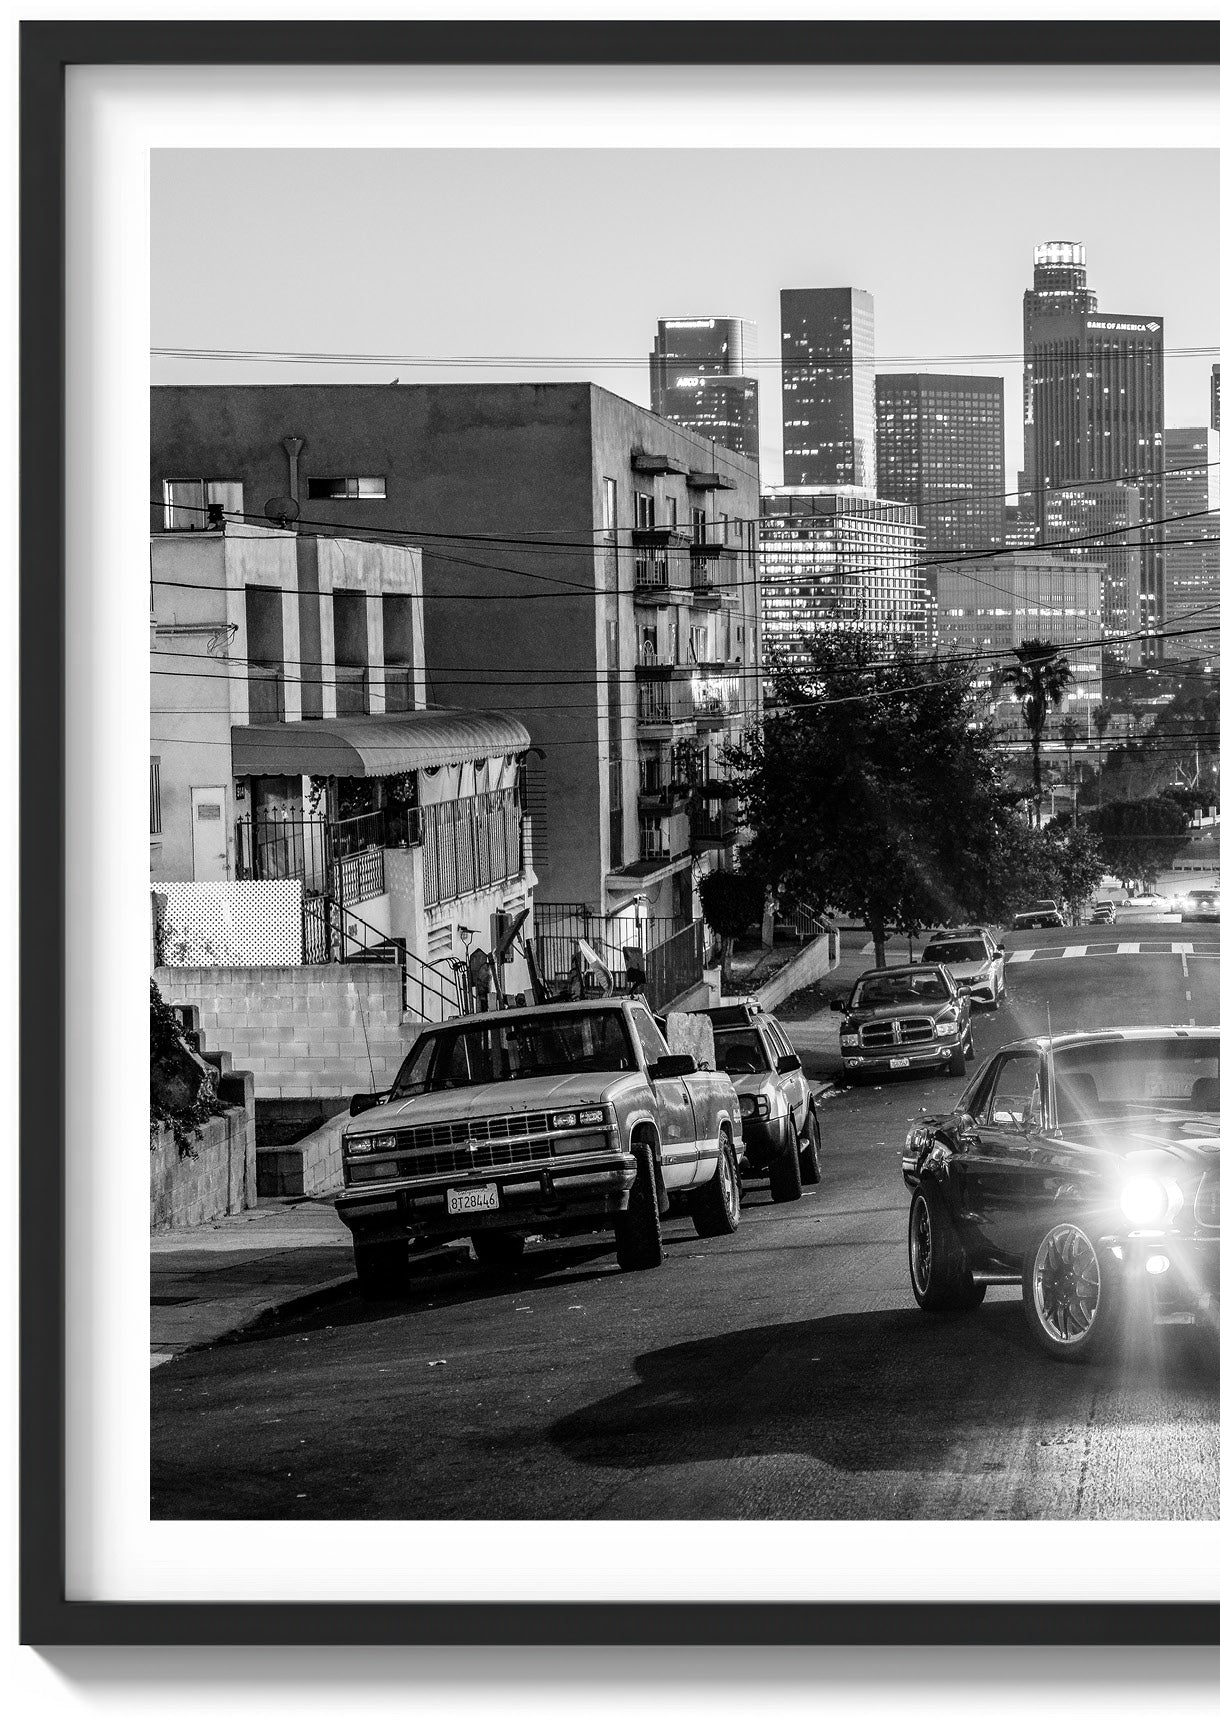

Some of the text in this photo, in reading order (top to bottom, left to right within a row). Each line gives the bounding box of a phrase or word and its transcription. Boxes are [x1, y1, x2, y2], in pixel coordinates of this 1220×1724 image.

[1087, 321, 1106, 329] BANK
[1116, 323, 1147, 331] AMERICA
[451, 1193, 495, 1210] 8T28446
